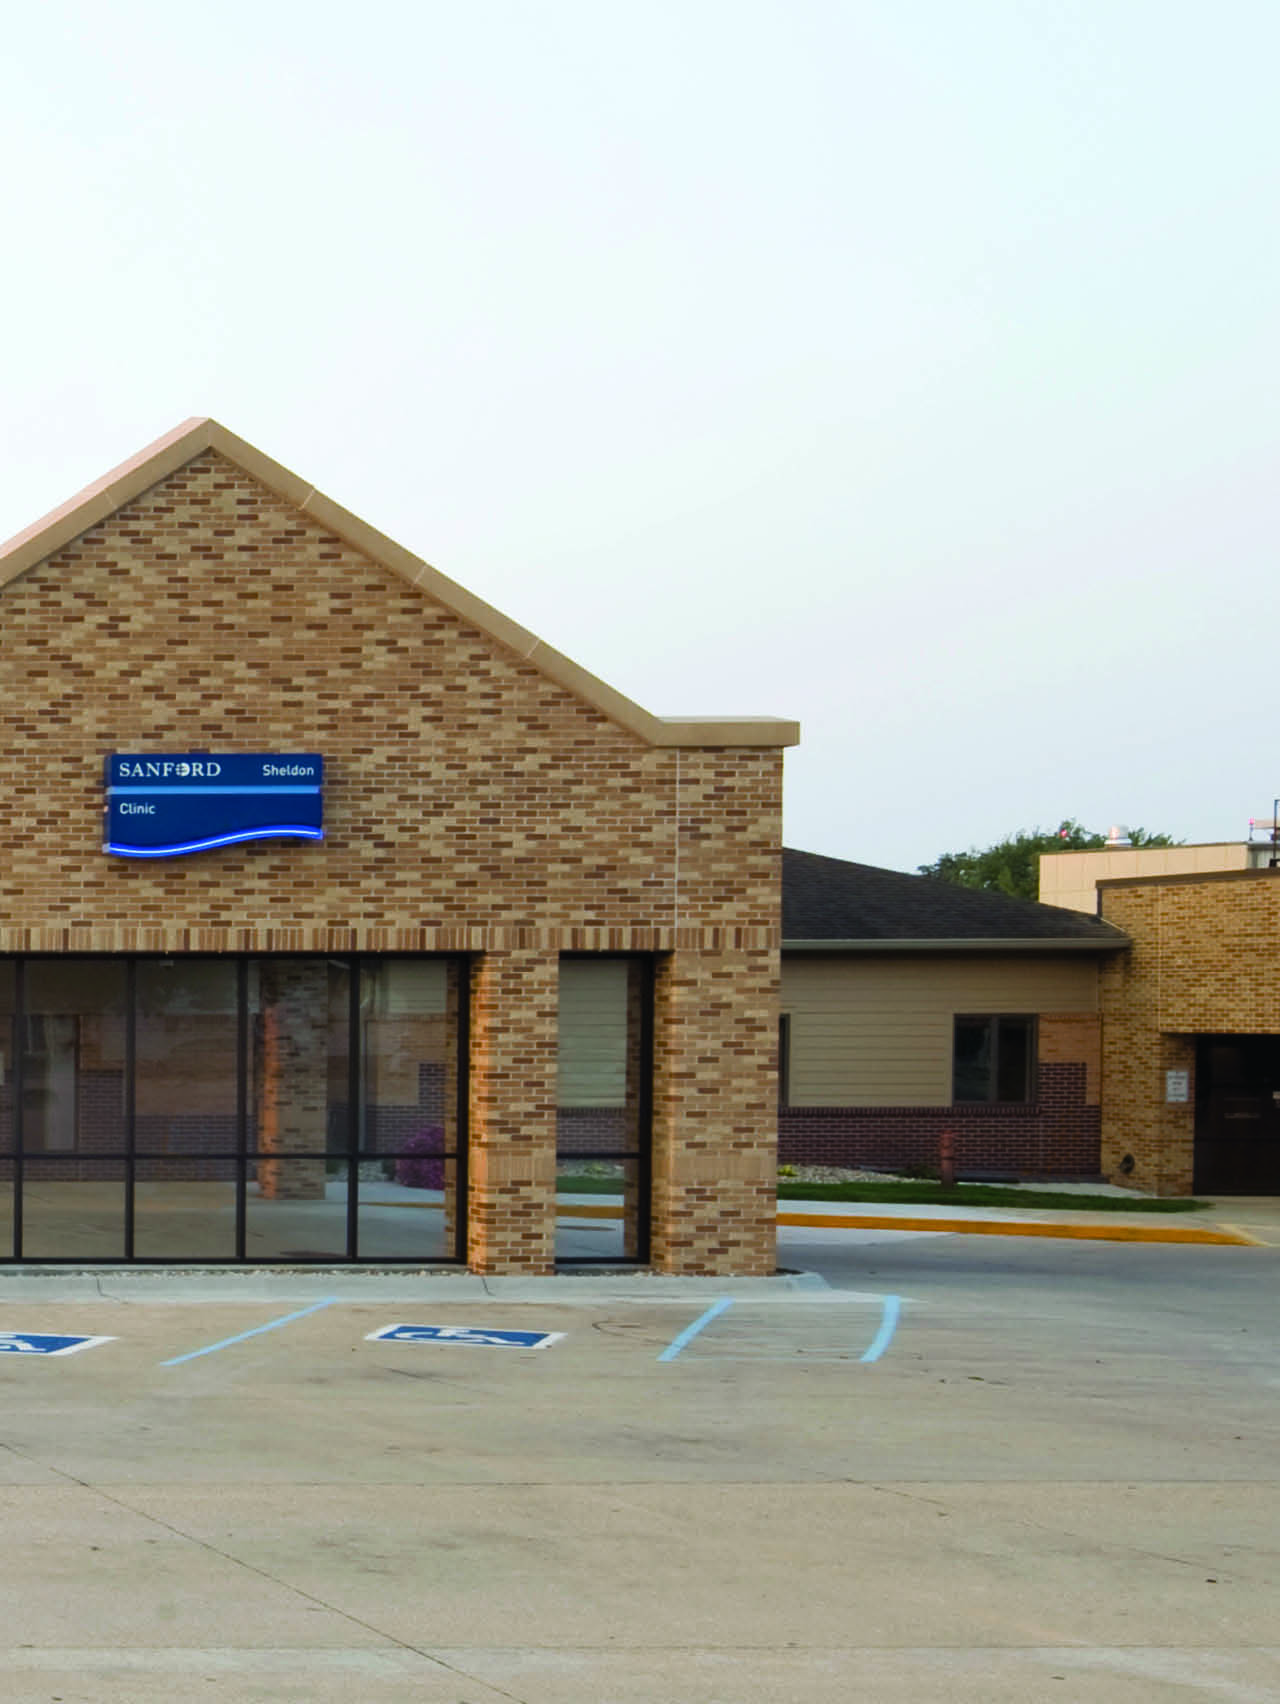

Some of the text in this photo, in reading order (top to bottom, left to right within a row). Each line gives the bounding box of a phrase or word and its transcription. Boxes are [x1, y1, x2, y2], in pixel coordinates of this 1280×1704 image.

[119, 762, 221, 777] SANFORD
[262, 764, 315, 777] Sheldon
[119, 802, 156, 815] Clinic
